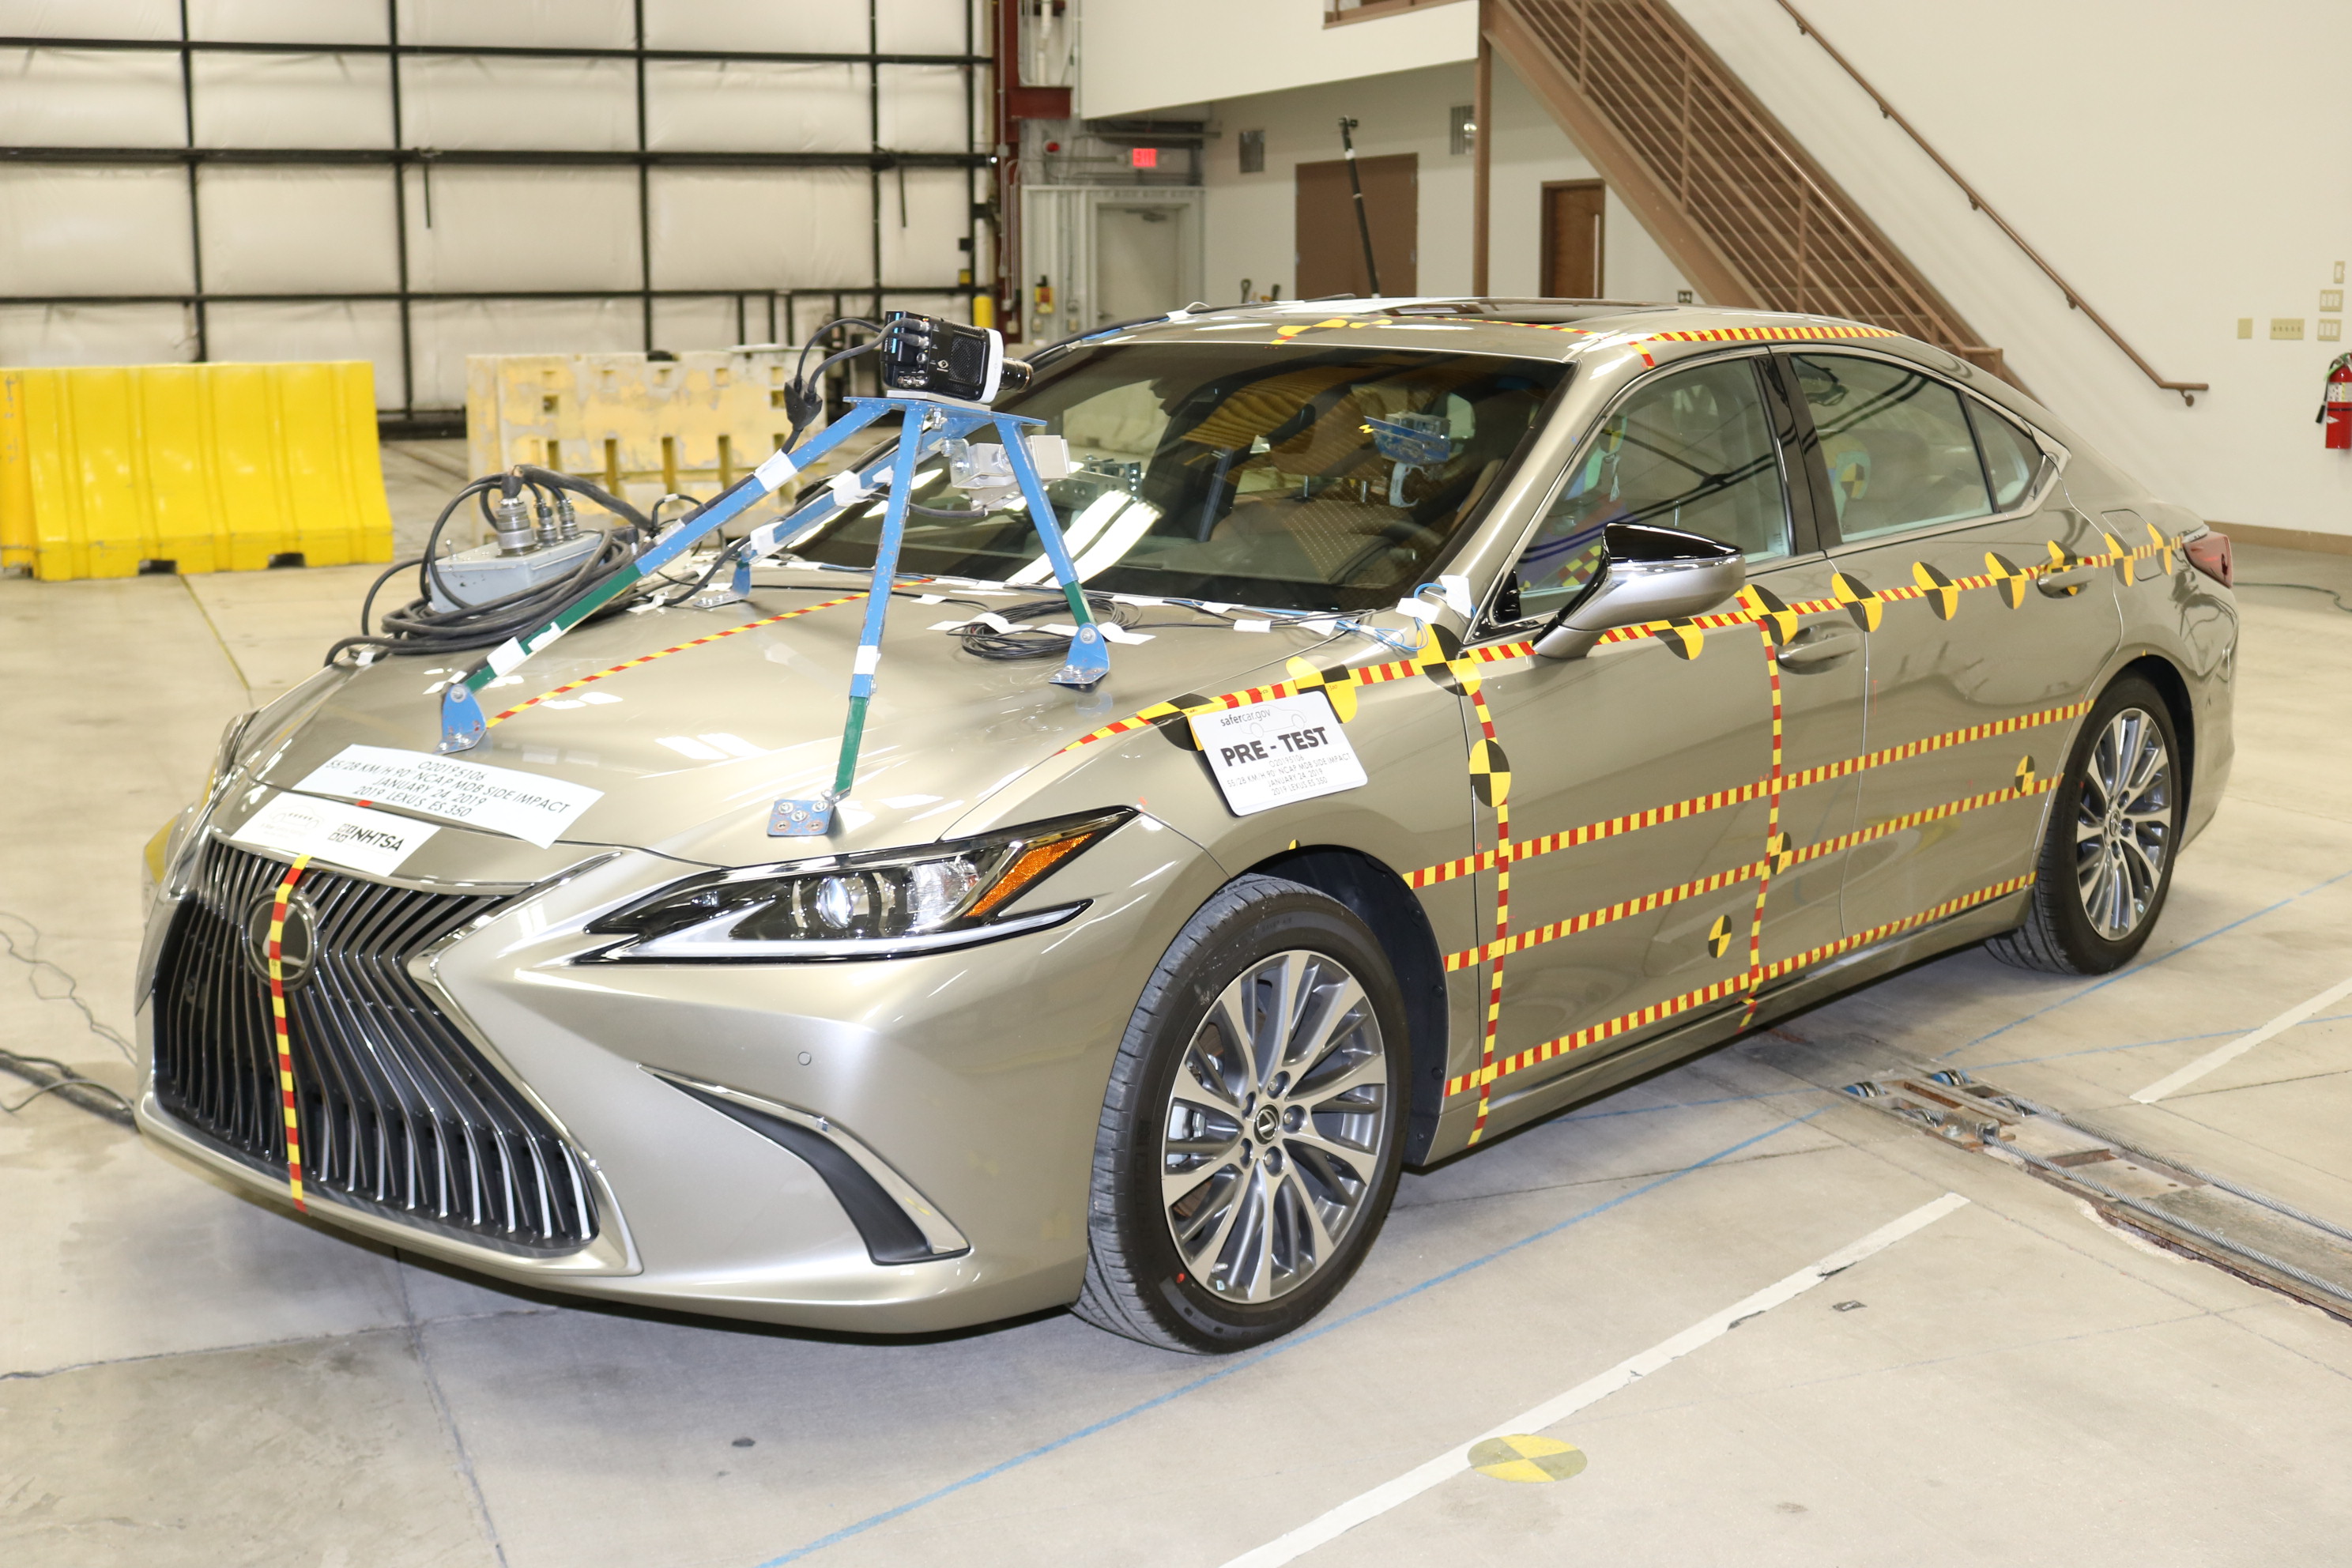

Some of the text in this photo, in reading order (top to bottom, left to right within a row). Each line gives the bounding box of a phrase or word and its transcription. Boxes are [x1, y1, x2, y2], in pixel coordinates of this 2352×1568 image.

[1219, 709, 1271, 726] safercar.gov
[1220, 740, 1269, 767] PRE
[1277, 726, 1329, 752] TEST
[1246, 771, 1267, 782] KM/H
[1278, 764, 1297, 775] NCAP
[1298, 761, 1314, 771] MDB
[1313, 758, 1328, 767] SIDE
[1327, 752, 1351, 764] IMPACT
[1268, 773, 1297, 788] JANUARY
[1308, 767, 1323, 778] 2019
[326, 760, 362, 771] 55/28
[361, 763, 395, 776] KM/H
[413, 771, 454, 786] NCAP
[450, 780, 484, 793] MDB
[483, 786, 516, 801] SIDE
[513, 793, 571, 814] IMPACT
[372, 777, 433, 794] JANUARY
[452, 793, 488, 807] 2019
[1271, 776, 1329, 796] 2019 LEXUS ES 350
[352, 786, 473, 818] 2019 LEXUS ES 350
[349, 827, 405, 852] NHTSA
